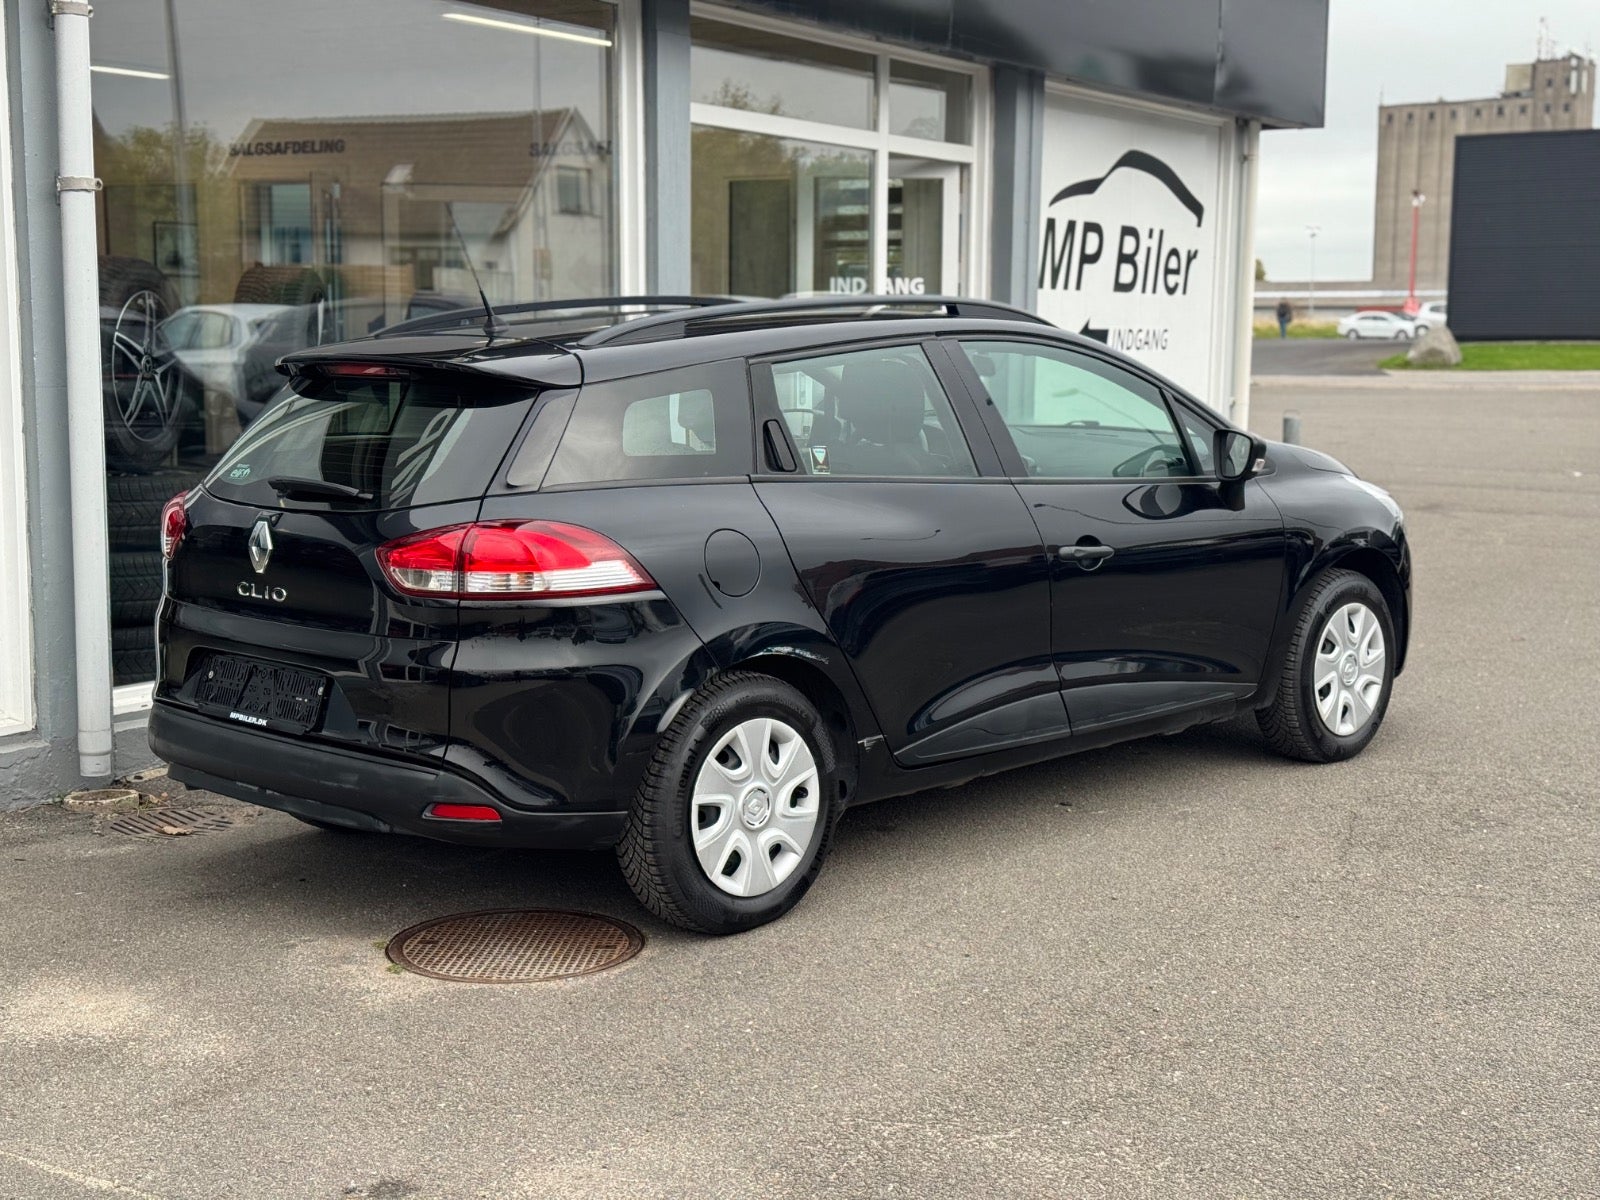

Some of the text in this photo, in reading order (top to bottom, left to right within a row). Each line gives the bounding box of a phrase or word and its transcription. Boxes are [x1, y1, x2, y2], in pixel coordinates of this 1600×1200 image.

[1038, 217, 1198, 296] MP Biler
[830, 277, 925, 296] INDANG
[1112, 328, 1169, 351] INDGANG
[236, 581, 287, 602] CLIO
